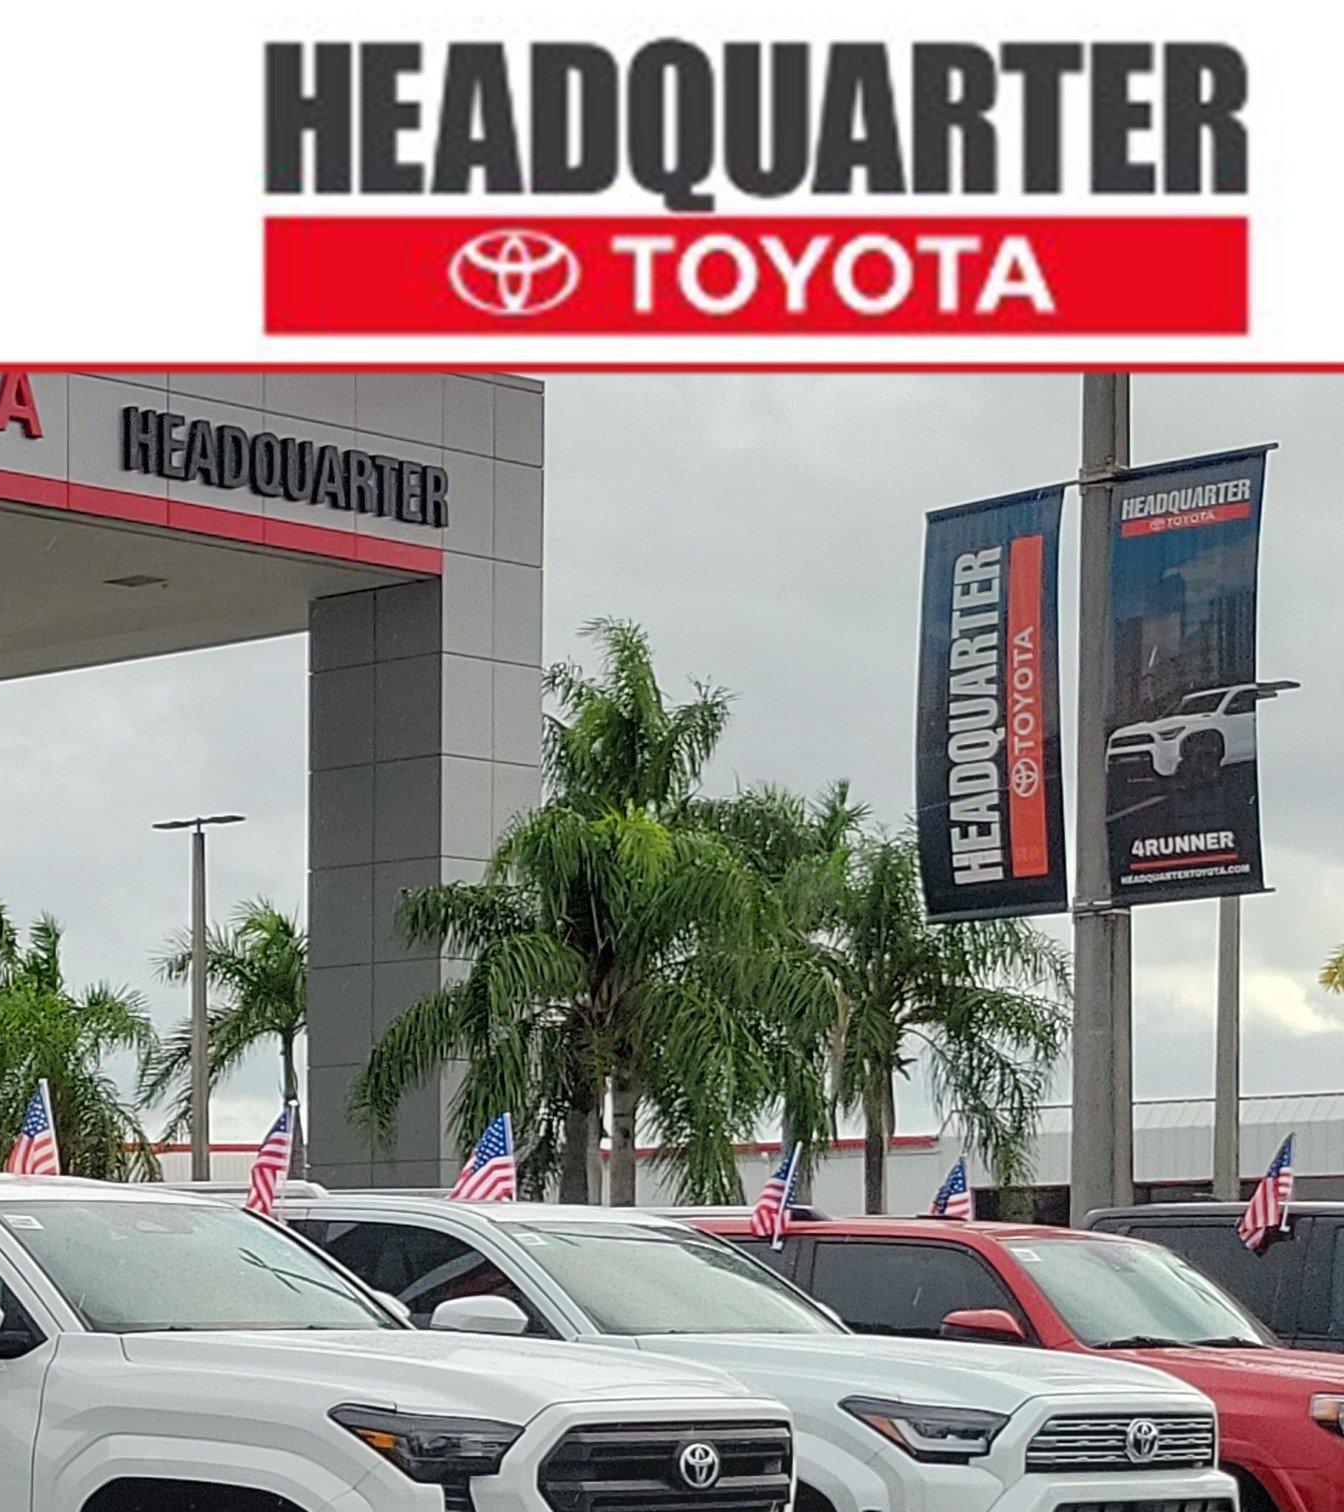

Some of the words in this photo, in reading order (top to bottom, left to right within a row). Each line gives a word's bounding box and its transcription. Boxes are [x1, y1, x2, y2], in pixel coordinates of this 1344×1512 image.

[123, 406, 449, 528] HEADQUARTER
[1121, 479, 1251, 520] HEADQUARTER
[1167, 511, 1216, 527] TOYOTA
[948, 546, 1005, 885] HEADQUARTER
[1013, 626, 1035, 756] TOYOTA
[1131, 831, 1235, 857] 4RUNNER
